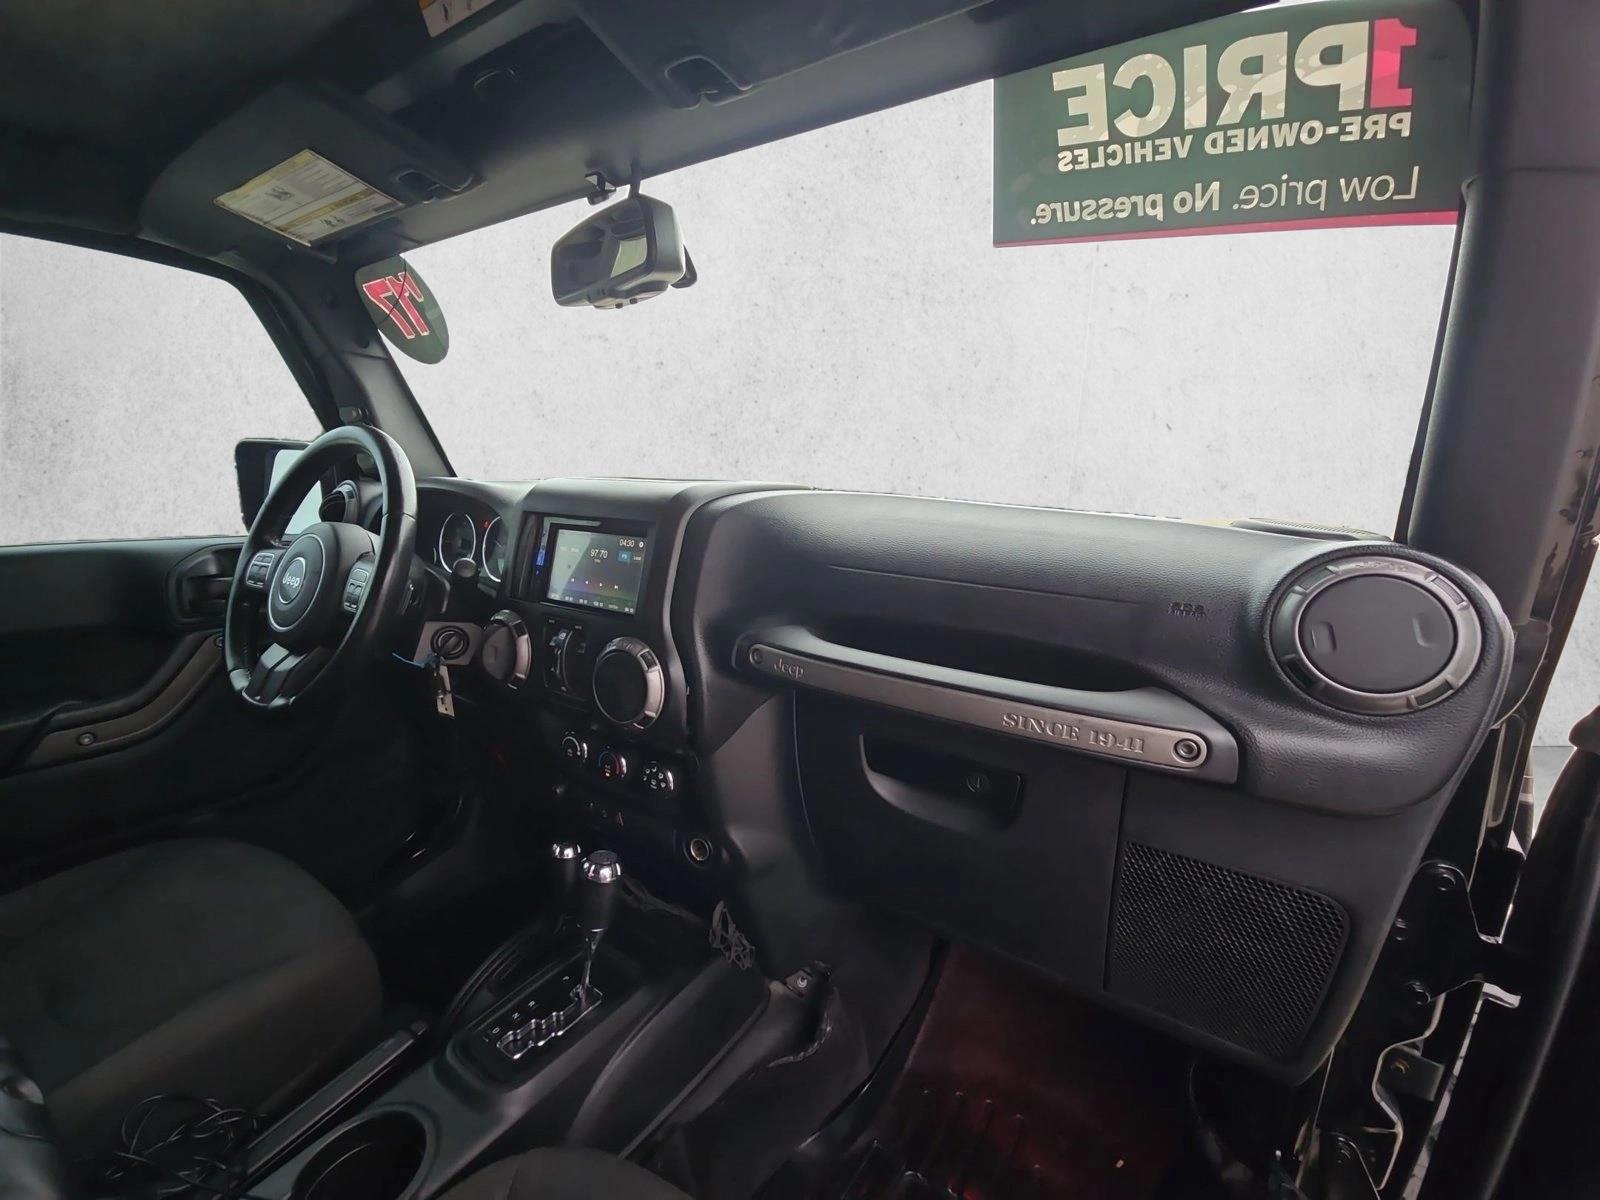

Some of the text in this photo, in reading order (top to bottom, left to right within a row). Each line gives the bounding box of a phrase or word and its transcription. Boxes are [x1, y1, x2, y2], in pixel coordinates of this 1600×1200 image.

[283, 572, 301, 587] Jeep
[774, 658, 804, 679] Jeep
[1002, 713, 1145, 754] SINCE 1941
